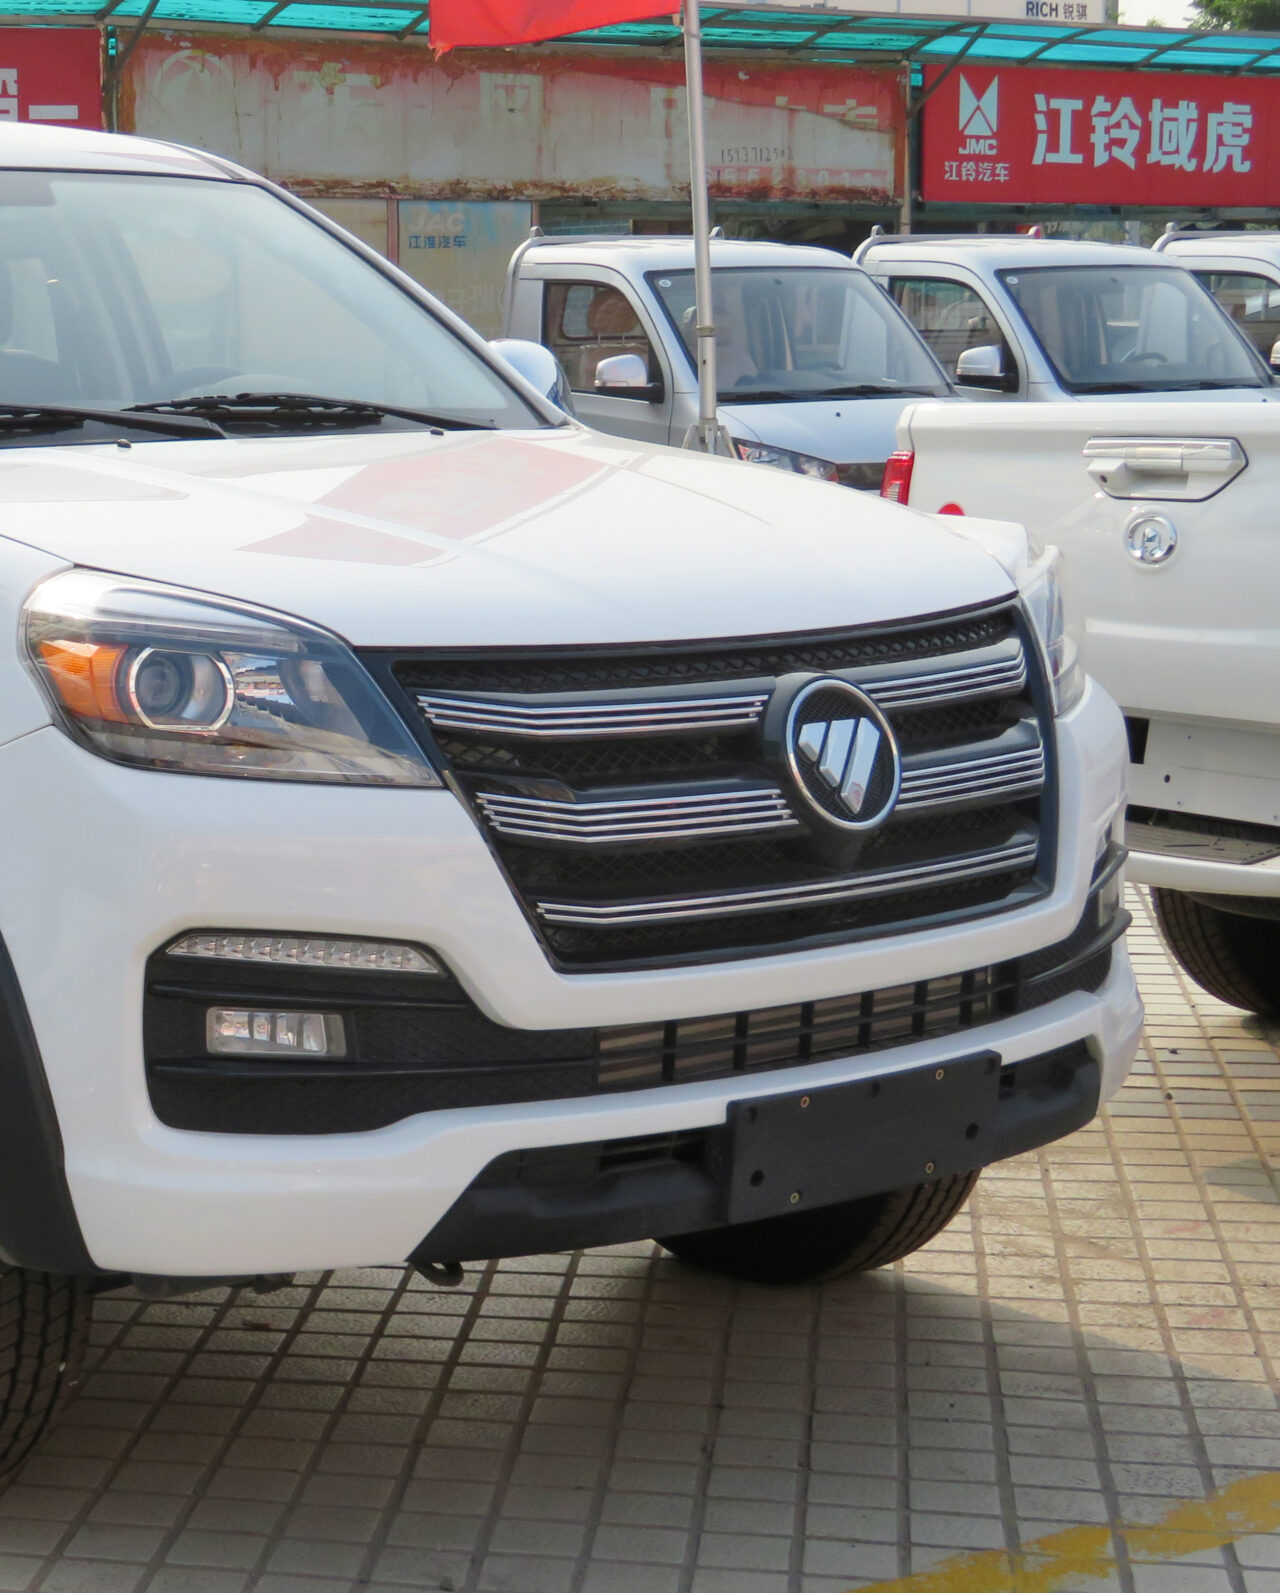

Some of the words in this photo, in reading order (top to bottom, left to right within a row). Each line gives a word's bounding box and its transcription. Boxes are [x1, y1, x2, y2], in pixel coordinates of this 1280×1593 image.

[1025, 1, 1059, 18] RICH
[1032, 93, 1253, 173] 江铃域虎
[958, 138, 997, 155] JMC
[944, 161, 1009, 182] 江铃汽车
[407, 212, 466, 233] JAC
[408, 235, 467, 249] 江淮汽车
